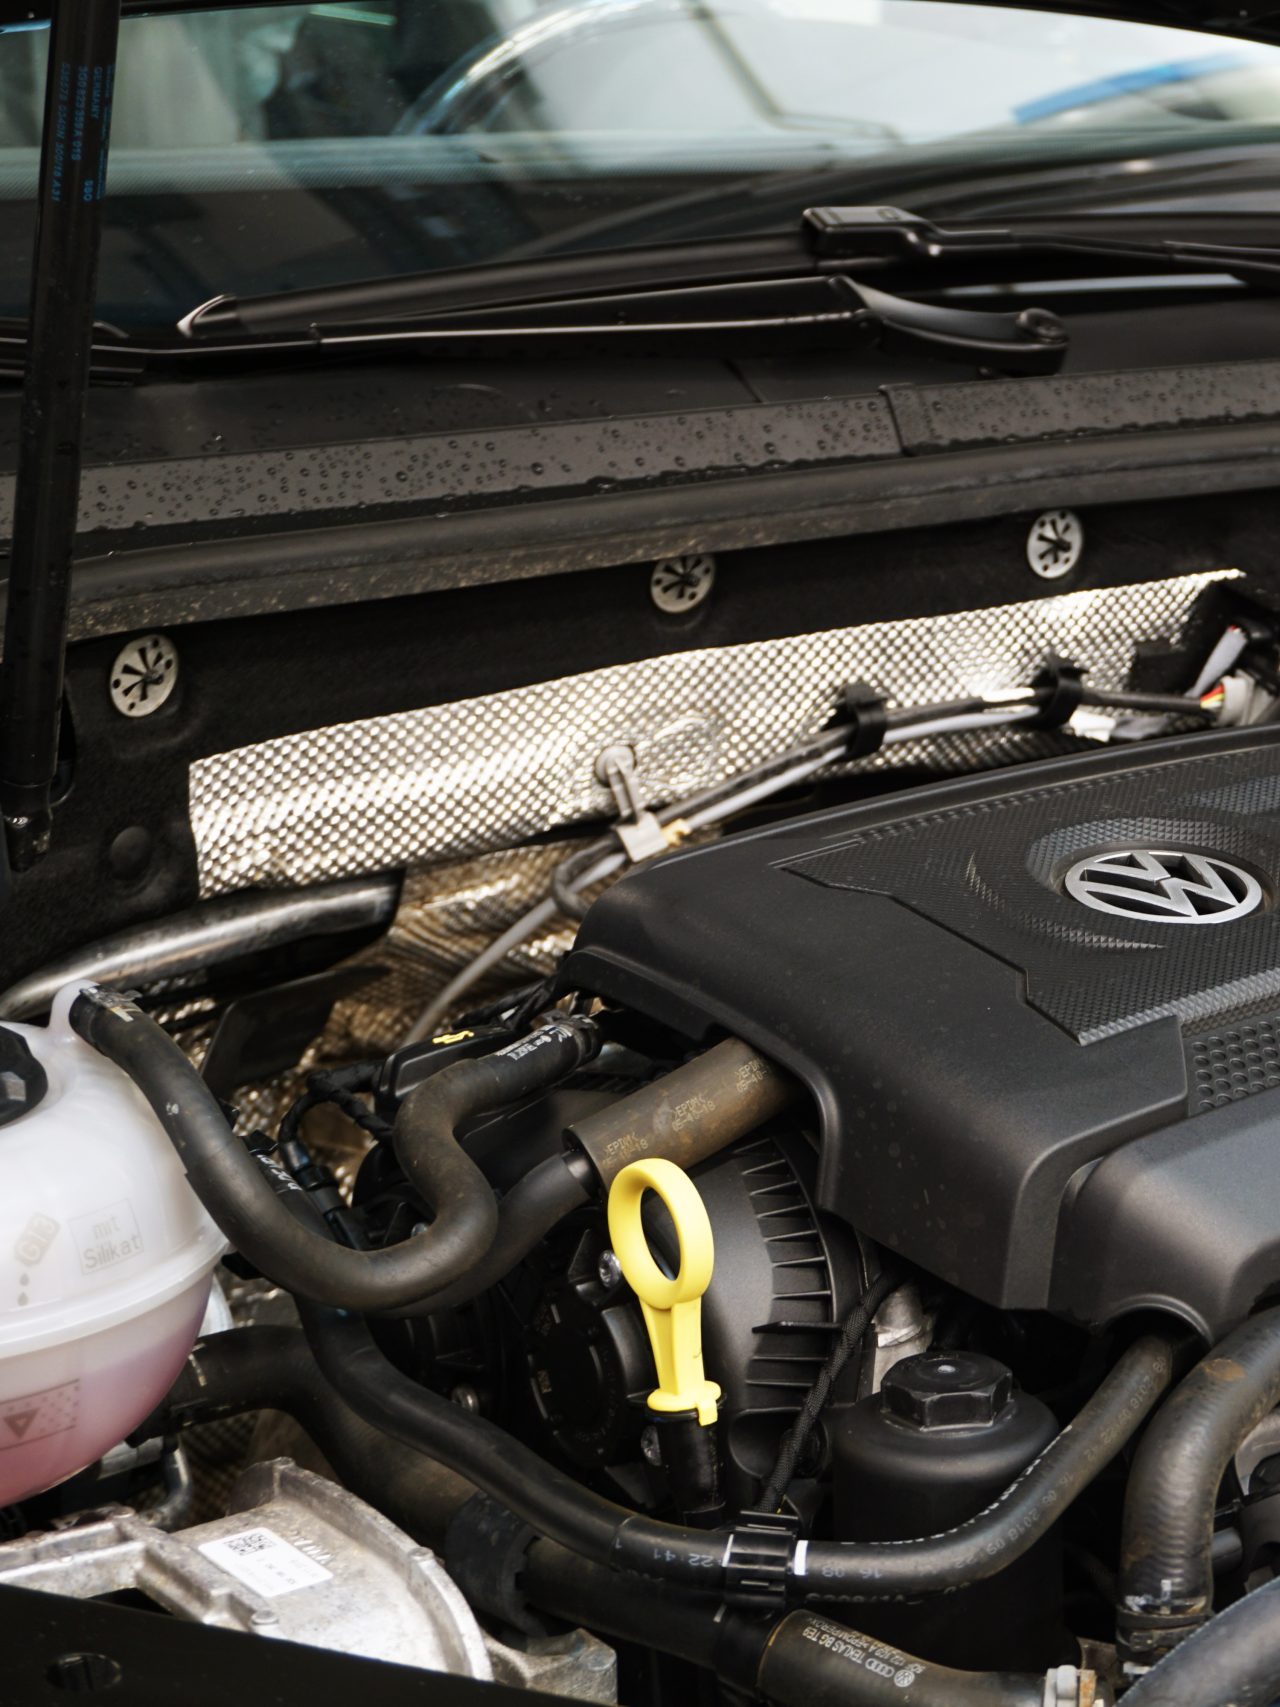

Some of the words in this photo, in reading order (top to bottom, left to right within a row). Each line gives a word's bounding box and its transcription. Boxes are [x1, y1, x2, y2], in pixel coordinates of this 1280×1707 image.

[91, 66, 103, 119] GERMANY
[91, 1215, 121, 1240] mit
[83, 1233, 143, 1269] Silikat
[819, 1633, 836, 1649] BG
[831, 1641, 866, 1664] TEKLAS
